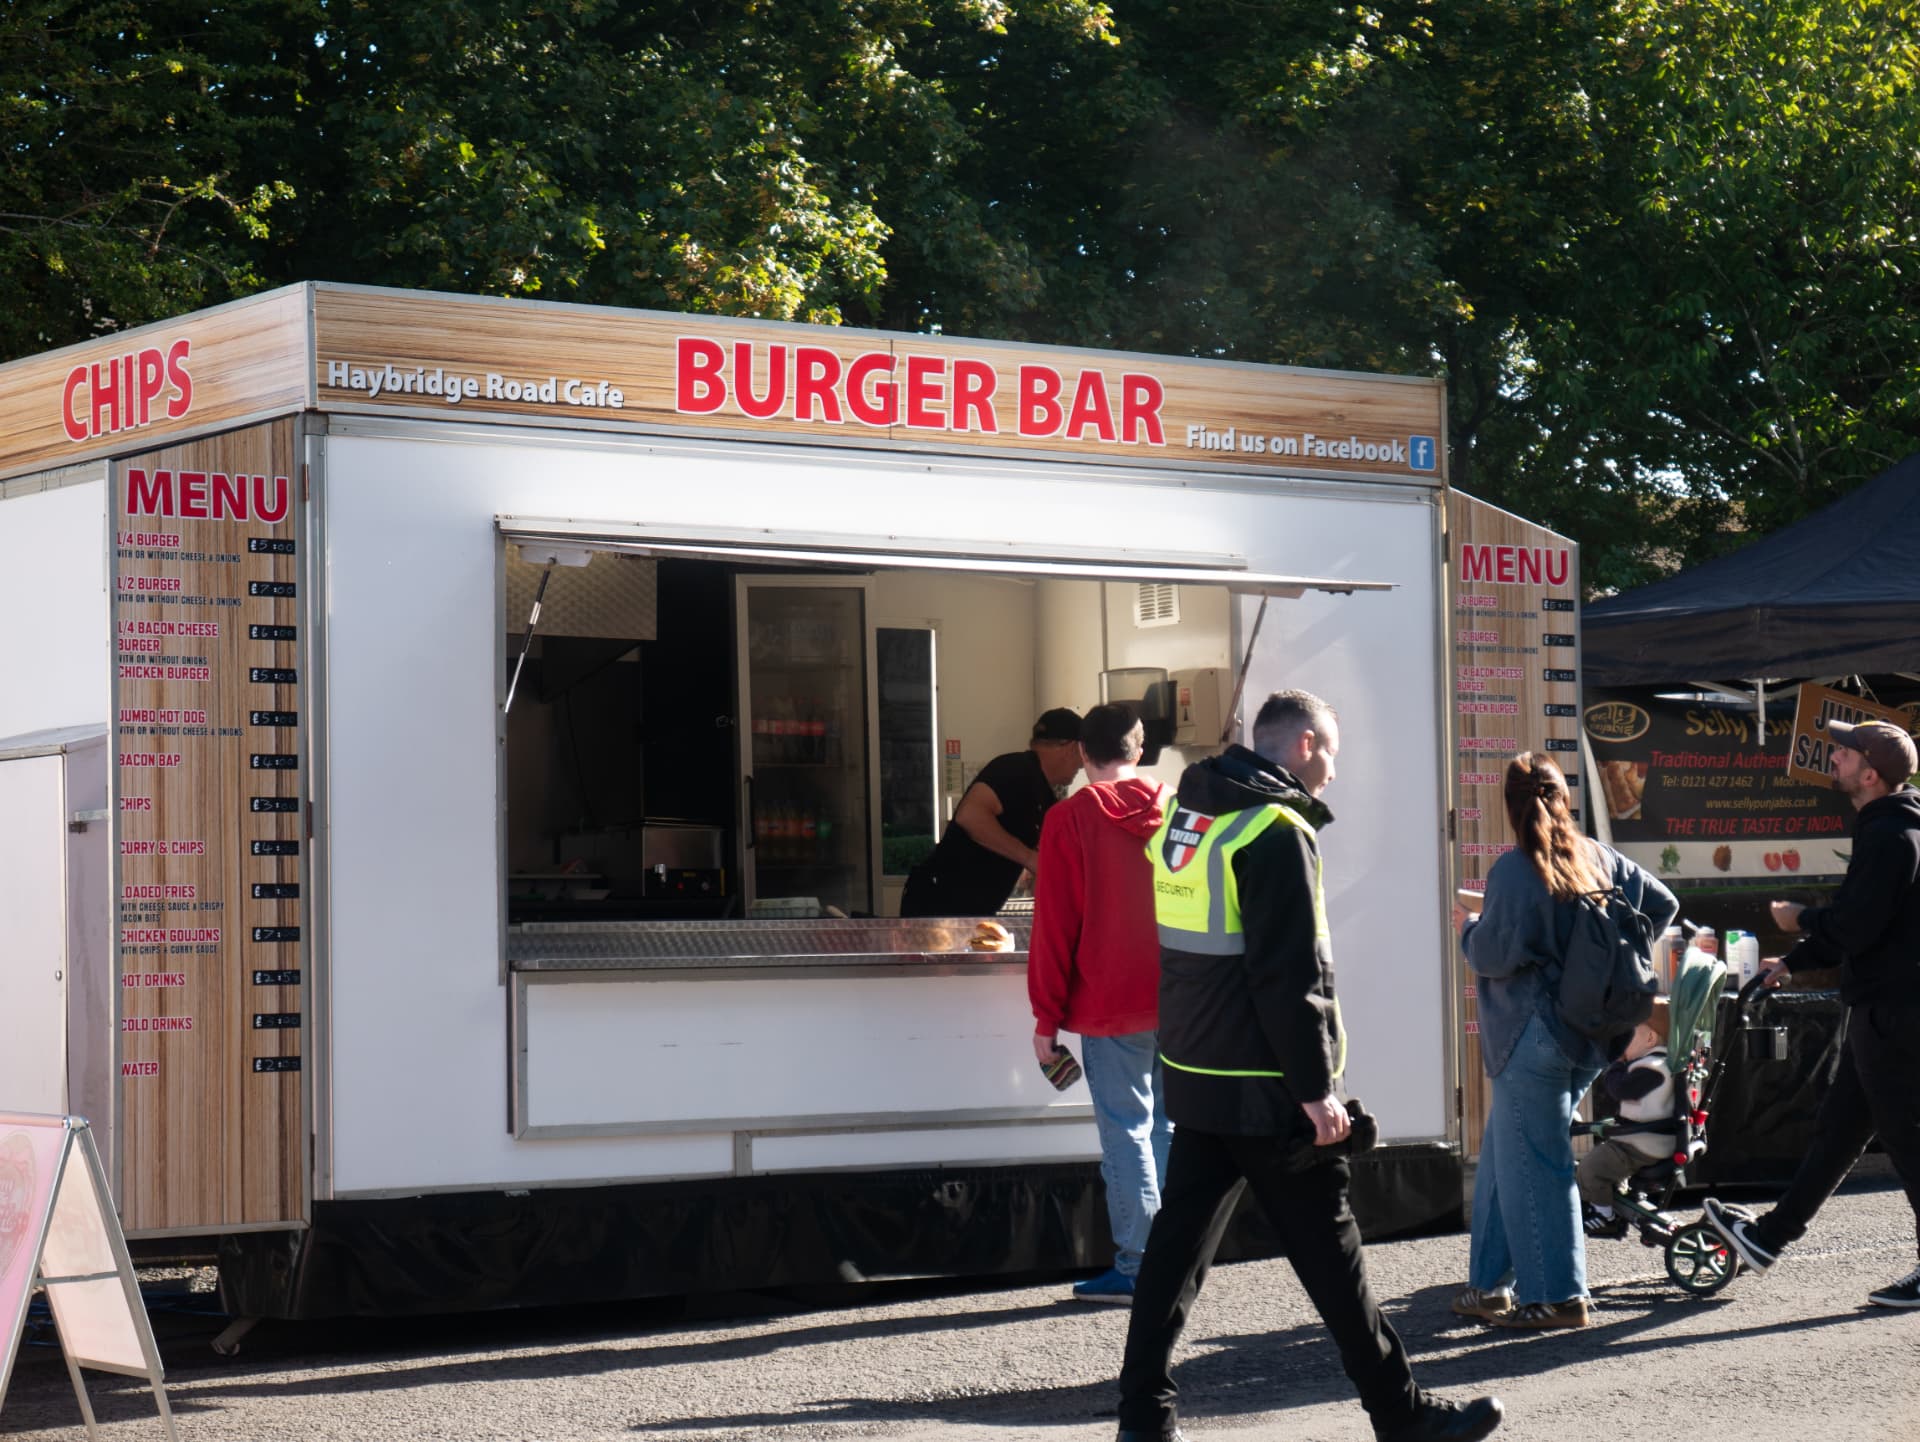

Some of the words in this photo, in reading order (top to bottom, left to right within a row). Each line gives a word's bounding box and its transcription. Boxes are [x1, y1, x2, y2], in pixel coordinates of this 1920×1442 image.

[63, 338, 193, 442] CHIPS
[327, 360, 480, 404] Haybridge
[486, 373, 557, 403] Road
[564, 378, 624, 408] Cafe
[676, 336, 999, 430] BURGER
[1017, 363, 1167, 447] BAR
[1186, 424, 1236, 451] Find
[1241, 433, 1265, 454] us
[1270, 437, 1299, 456] on
[1303, 433, 1406, 463] Facebook
[126, 468, 289, 524] MENU
[137, 533, 180, 548] BURGER
[136, 550, 145, 559] OR
[148, 550, 178, 560] WITHOUT
[180, 551, 206, 561] CHEESE
[216, 553, 241, 563] ONIONS
[1461, 543, 1569, 587] MENU
[138, 577, 180, 591] BURGER
[148, 595, 178, 604] WITHOUT
[181, 596, 206, 605] CHEESE
[216, 597, 242, 607] ONIONS
[138, 621, 175, 635] BACON
[178, 622, 218, 637] CHEESE
[136, 655, 146, 664] OR
[149, 655, 179, 665] WITHOUT
[181, 656, 208, 665] ONIONS
[119, 666, 164, 679] CHICKEN
[167, 667, 209, 680] BURGER
[120, 710, 156, 723] JUMBO
[159, 710, 180, 723] HOT
[183, 711, 206, 724] DOG
[150, 727, 180, 736] WITHOUT
[183, 727, 208, 736] CHEESE
[218, 728, 243, 737] ONIONS
[1685, 710, 1748, 744] Selly
[120, 754, 155, 766] BACON
[158, 754, 181, 766] BAP
[1651, 751, 1731, 768] Traditional
[1681, 776, 1707, 788] 0121
[120, 798, 151, 810] CHIPS
[1665, 817, 1696, 835] THE
[1700, 817, 1738, 835] TRUE
[1742, 816, 1783, 834] TASTE
[1785, 816, 1804, 833] OF
[1807, 815, 1844, 833] INDIA
[159, 842, 168, 854] &
[172, 842, 204, 854] CHIPS
[121, 885, 161, 898] OADED
[165, 885, 195, 898] FRIES
[1156, 880, 1195, 899] SECURITY
[139, 902, 166, 911] CHEESE
[168, 902, 190, 911] SAUCE
[200, 902, 224, 911] CRISPY
[121, 930, 166, 943] CHICKEN
[170, 929, 220, 942] GOUJONS
[139, 946, 161, 955] CHIPS
[144, 974, 185, 986] DRINKS
[122, 1019, 148, 1031] COLD
[152, 1017, 192, 1030] DRINKS
[122, 1062, 158, 1076] WATER
